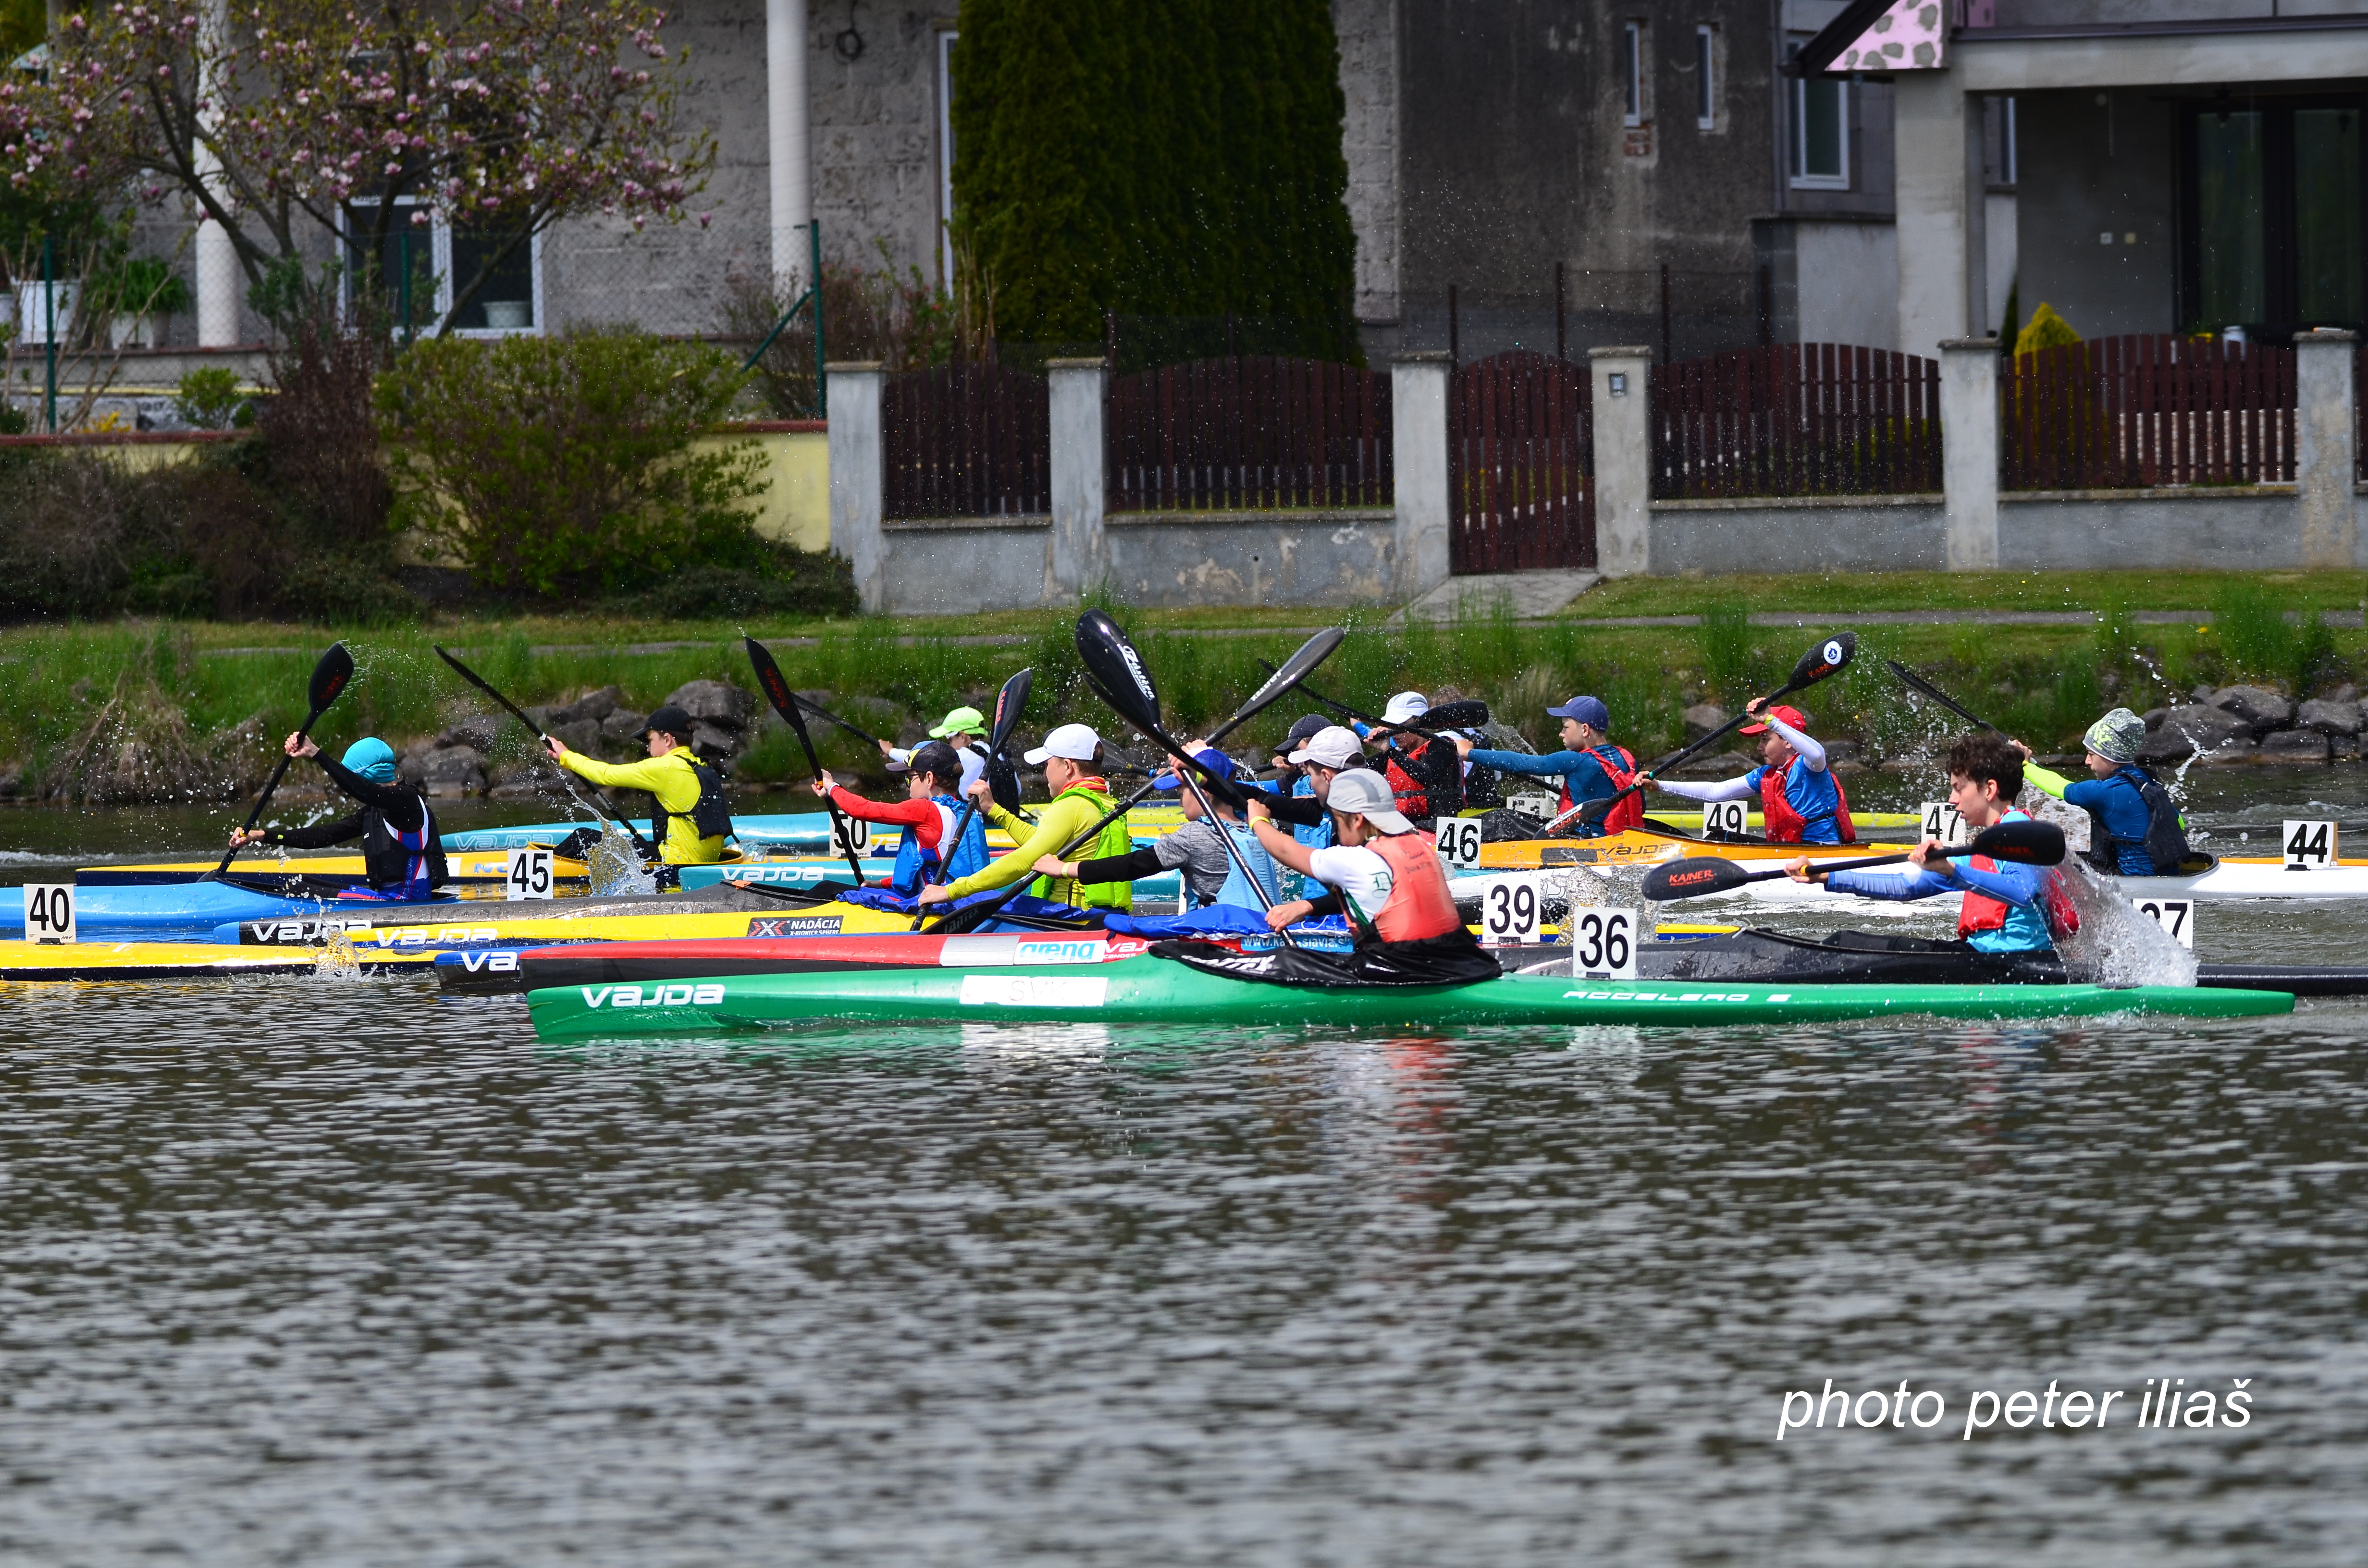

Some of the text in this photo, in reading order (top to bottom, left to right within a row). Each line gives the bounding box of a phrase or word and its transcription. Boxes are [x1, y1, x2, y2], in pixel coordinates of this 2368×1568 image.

[834, 814, 867, 850] 50
[1706, 804, 1741, 833] 49
[1926, 805, 1961, 841] 47
[1438, 823, 1479, 862] 46
[2287, 823, 2328, 863] 44
[511, 853, 549, 893] 45
[1668, 870, 1714, 883] KAINER
[30, 887, 70, 932] 40
[791, 918, 840, 929] NADÁCIA
[1490, 884, 1535, 934] 39
[1020, 943, 1096, 960] arena
[1580, 914, 1628, 969] 36
